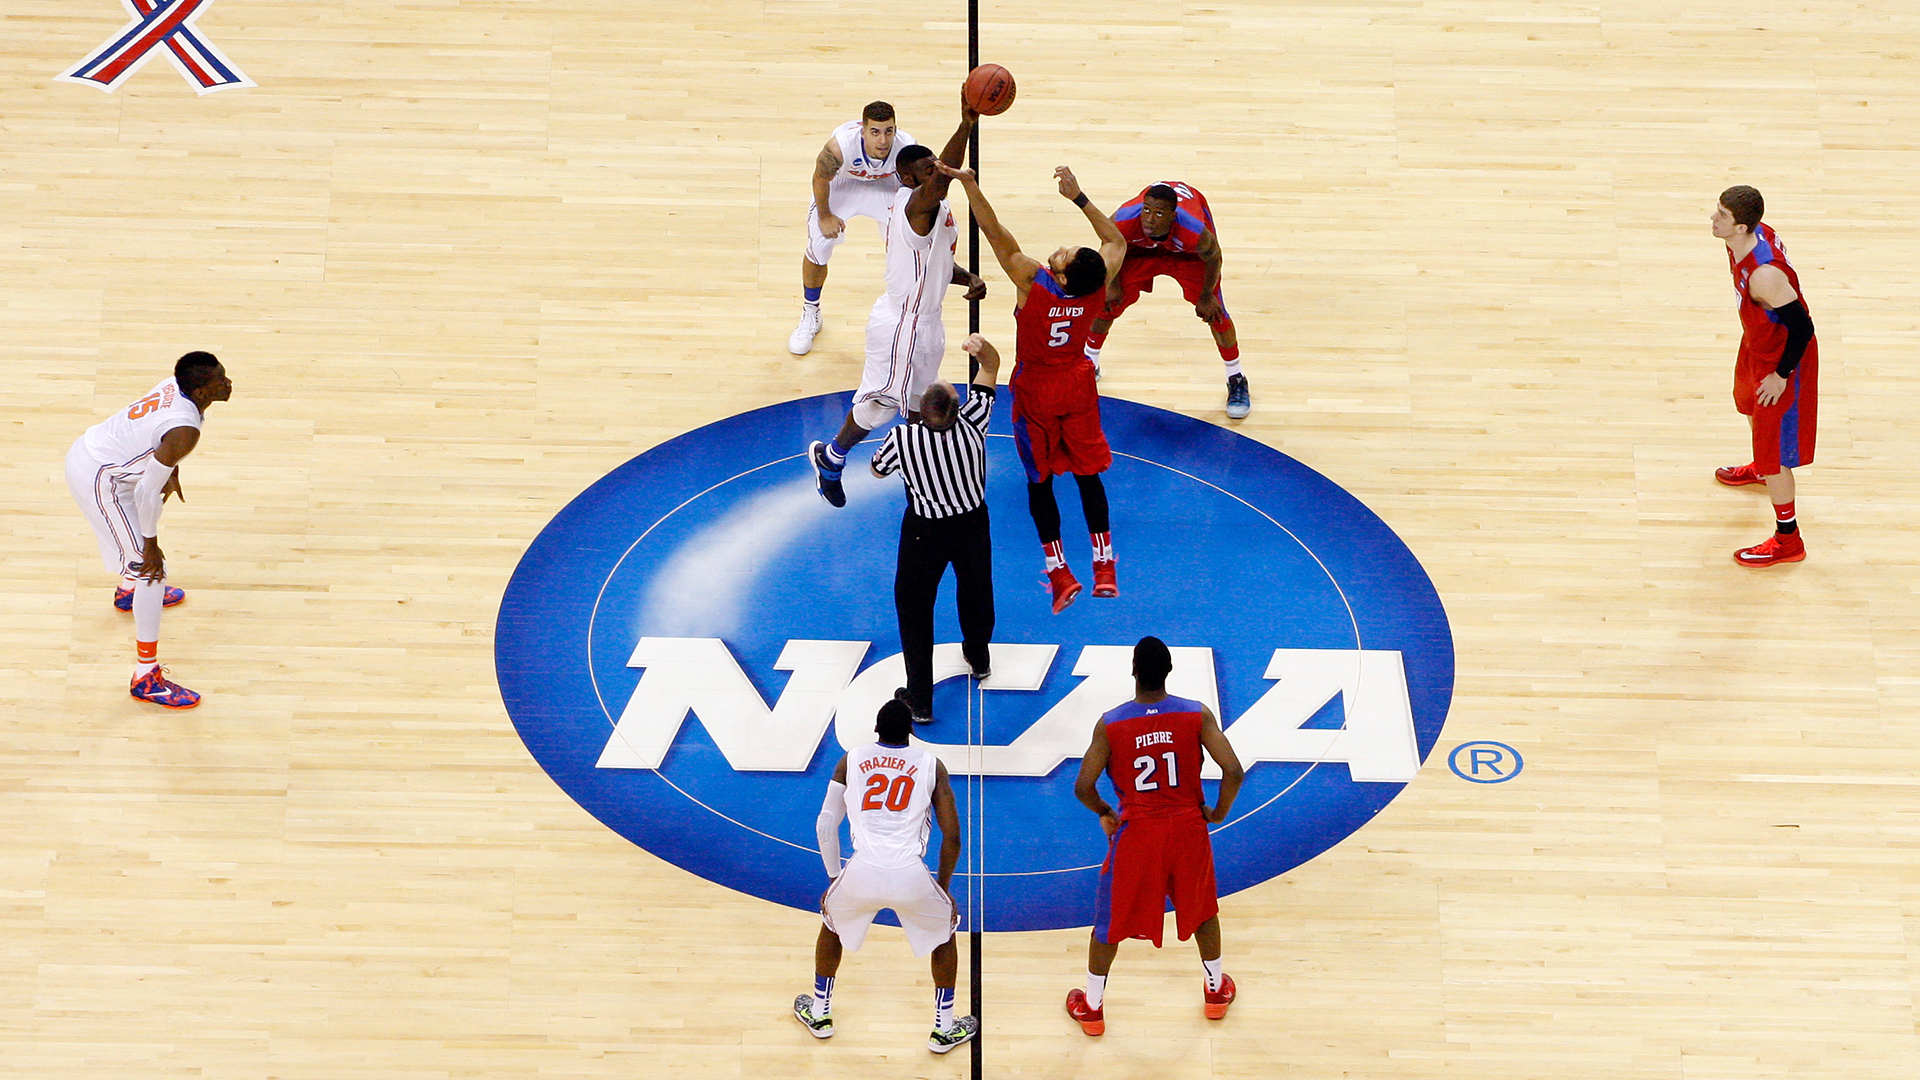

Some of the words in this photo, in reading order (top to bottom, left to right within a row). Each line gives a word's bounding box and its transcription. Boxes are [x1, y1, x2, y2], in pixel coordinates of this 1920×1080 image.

[1048, 306, 1084, 317] OLIVER
[1048, 321, 1071, 347] 5
[128, 392, 160, 420] 15
[595, 636, 1420, 783] NCAA
[1135, 731, 1173, 749] PIERRE
[859, 756, 906, 774] FRAZIER
[1133, 751, 1178, 792] 21
[861, 773, 915, 812] 20
